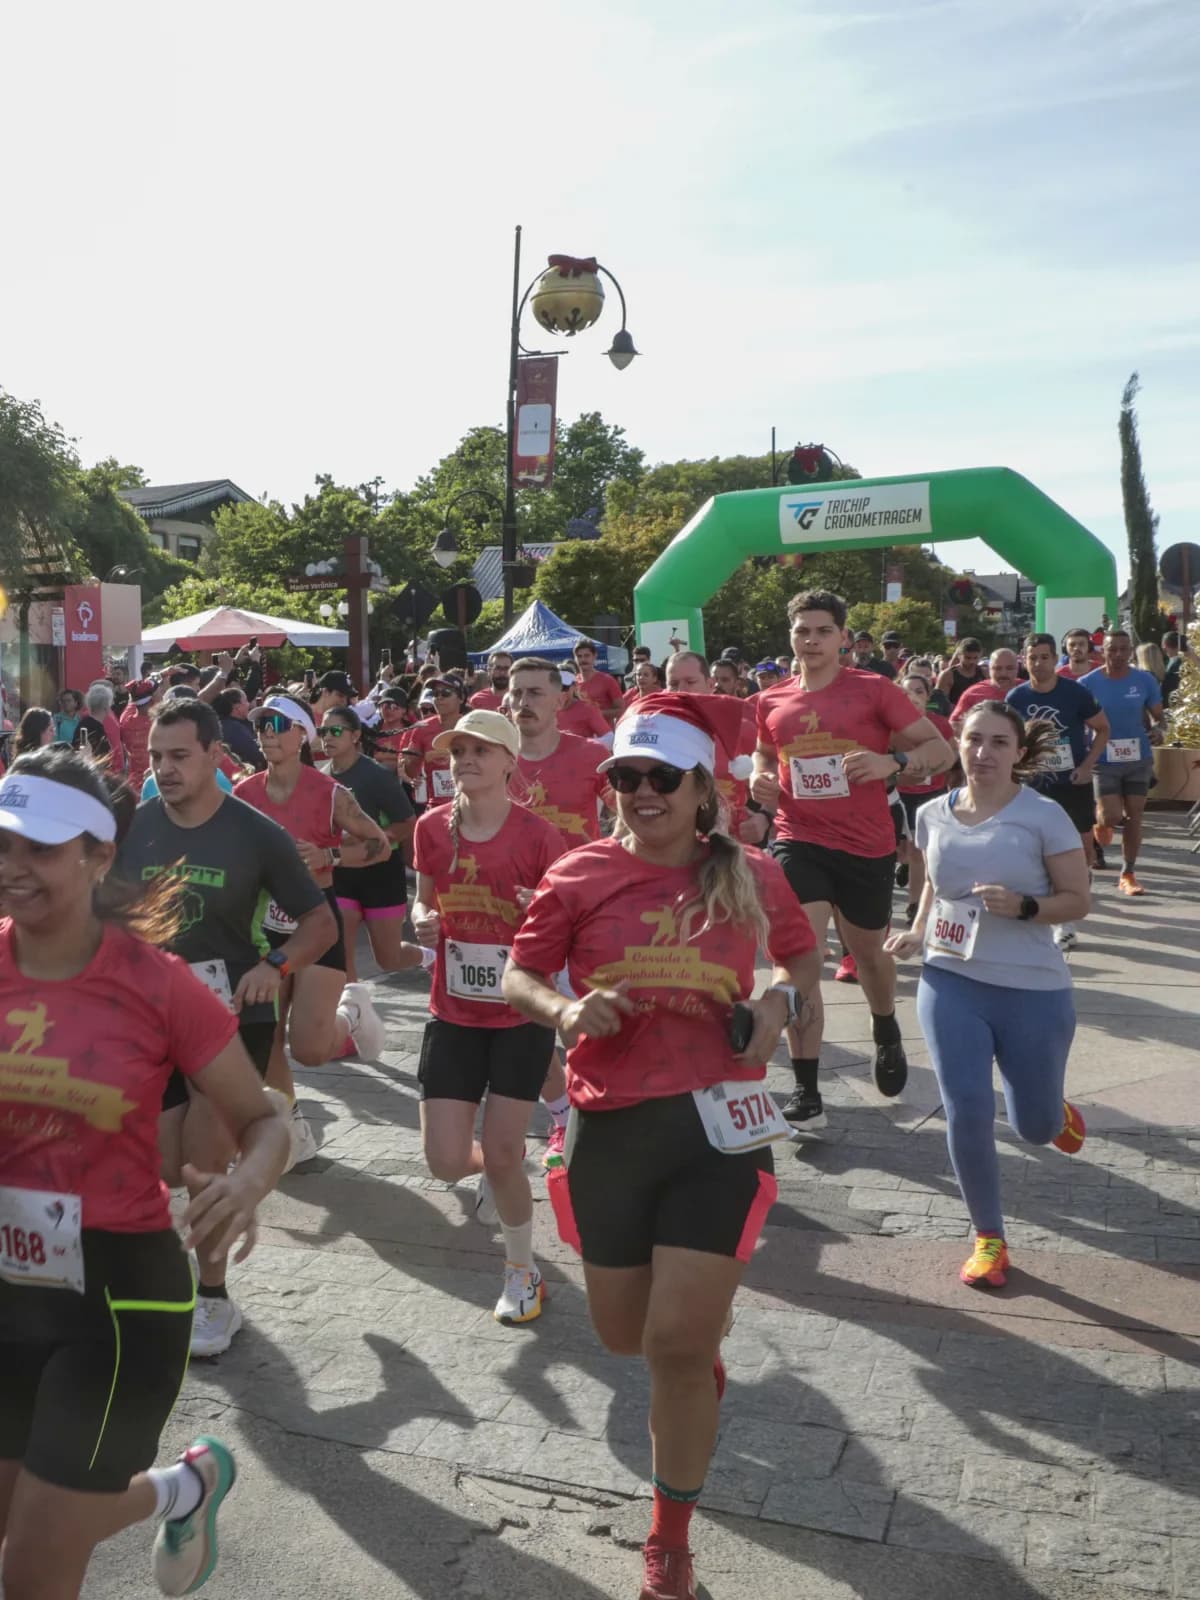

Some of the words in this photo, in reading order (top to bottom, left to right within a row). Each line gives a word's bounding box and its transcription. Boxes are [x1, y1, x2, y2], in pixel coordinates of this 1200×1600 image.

[826, 496, 871, 515] TRICHIP
[824, 507, 923, 531] CRONOMETRAGEM
[289, 583, 310, 591] Madre
[801, 773, 832, 790] 5236
[934, 918, 966, 945] 5040
[631, 951, 681, 965] Corrida
[460, 963, 497, 988] 1065
[725, 1090, 777, 1131] 5174
